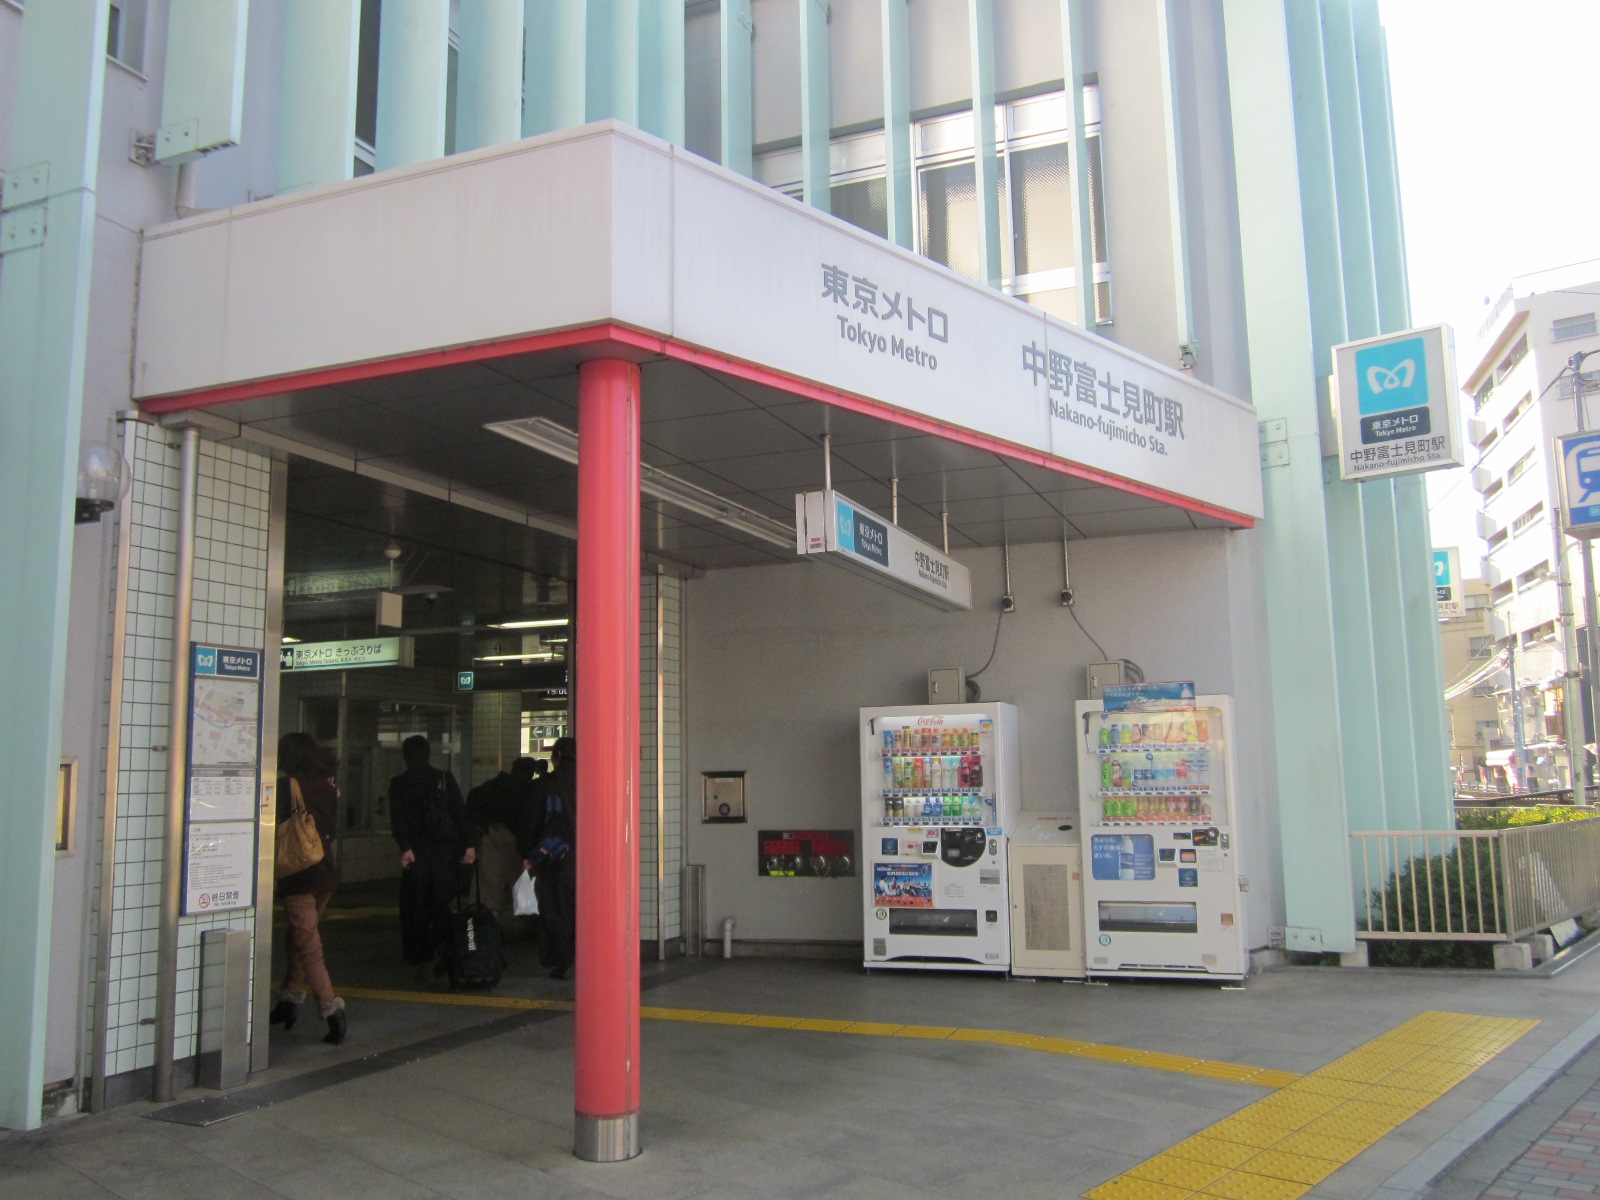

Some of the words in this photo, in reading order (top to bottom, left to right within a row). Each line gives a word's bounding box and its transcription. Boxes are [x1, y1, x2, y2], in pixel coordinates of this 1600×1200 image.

[821, 262, 949, 343] 東京メトロ
[837, 315, 886, 354] Tokyo
[891, 335, 938, 371] Metro
[1022, 340, 1185, 440] 中野富士見町駅
[1049, 398, 1147, 450] Nakano-fujimicho
[1149, 434, 1168, 456] Sta.
[1371, 414, 1419, 431] 東京メトロ
[1375, 429, 1395, 437] Tokyo
[1396, 425, 1417, 433] Metro
[1350, 436, 1446, 464] 中野富士見町駅
[1353, 454, 1425, 472] Nakano-fujimicho
[1427, 452, 1443, 460] Sta.
[859, 522, 883, 545] 東京メトロ
[222, 655, 253, 666] 東京メトロ
[295, 648, 332, 660] 東京メトロ
[335, 643, 382, 656] きっぷうりば
